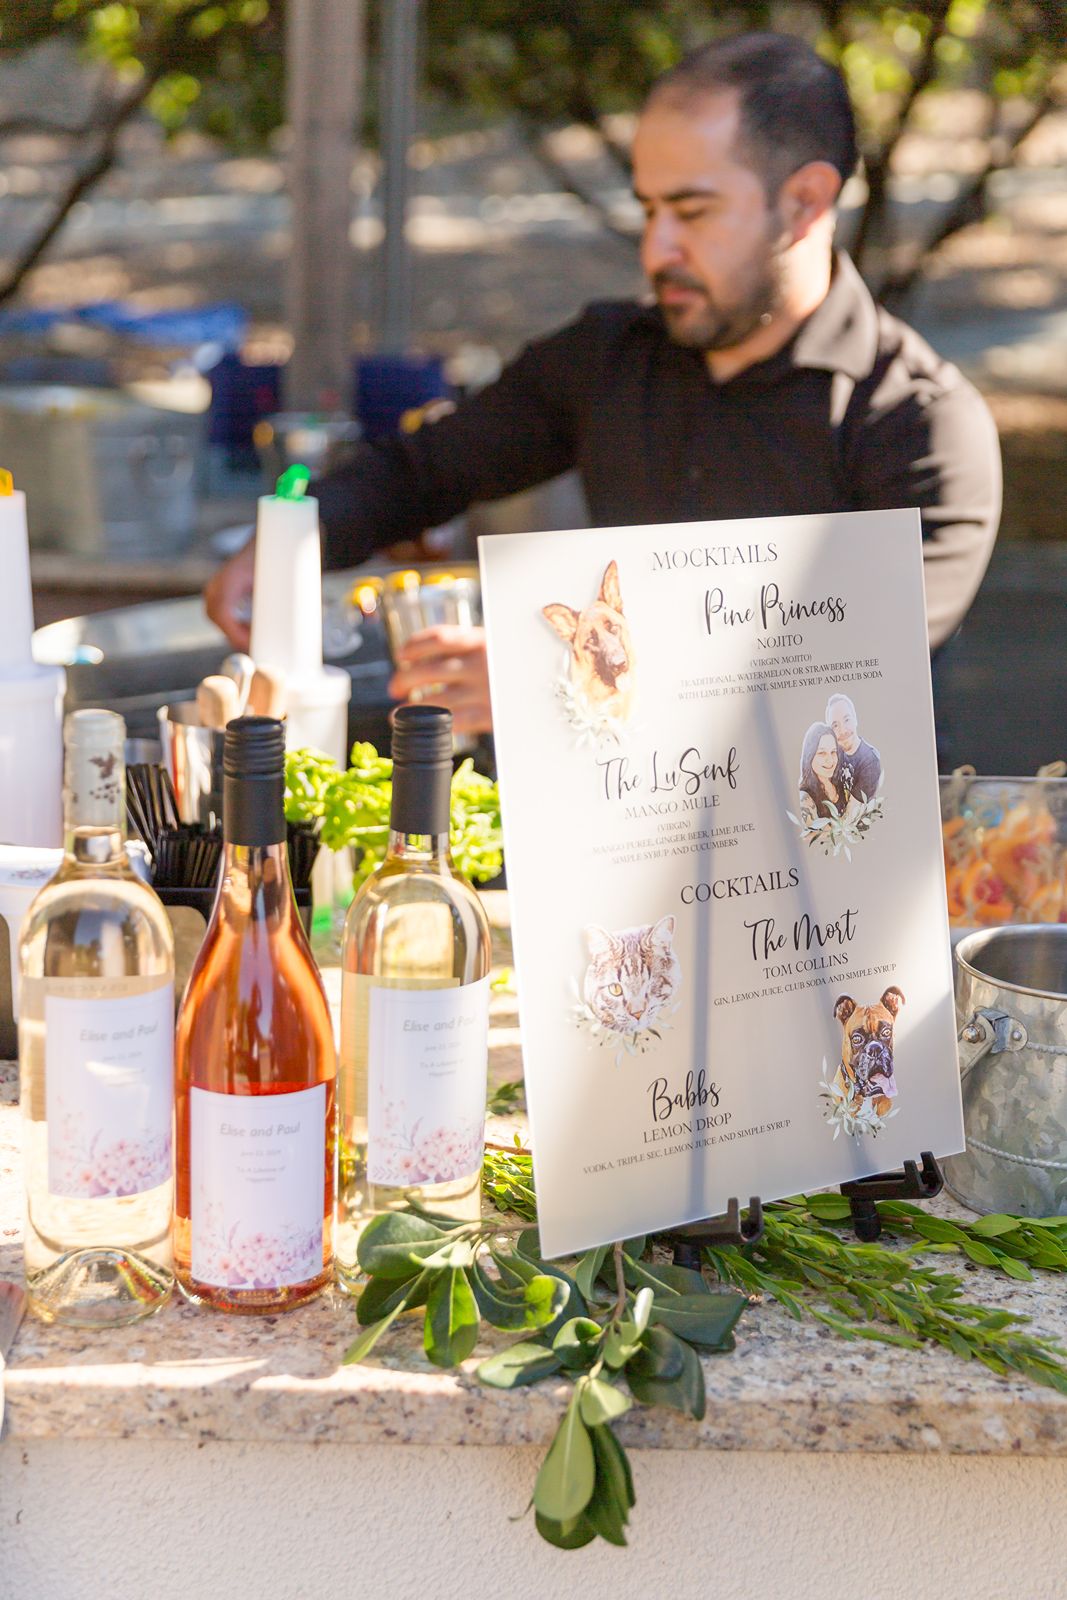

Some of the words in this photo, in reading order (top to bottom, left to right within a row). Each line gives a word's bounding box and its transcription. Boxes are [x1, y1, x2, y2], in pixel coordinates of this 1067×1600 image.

[652, 542, 778, 571] MOCKTAILS
[704, 587, 754, 635] Pine
[761, 583, 847, 630] Princess
[757, 633, 803, 649] NOJITO
[737, 667, 791, 681] WATERMELON
[792, 667, 804, 676] OR
[805, 661, 854, 674] STRAWBERRY
[855, 658, 879, 669] PUREE
[750, 656, 780, 667] (VIRGIN
[781, 654, 812, 664] MOJITO)
[678, 690, 699, 700] WITH
[700, 688, 721, 698] LIME
[747, 683, 769, 693] MINT,
[769, 678, 798, 690] SIMPLE
[799, 676, 823, 687] SYRUP
[824, 674, 841, 684] AND
[842, 672, 862, 682] CLUB
[863, 670, 883, 680] SODA
[596, 757, 641, 800] The
[624, 802, 678, 820] MANGO
[682, 795, 720, 812] MULE
[655, 834, 686, 846] GINGER
[711, 826, 732, 837] LIME
[657, 820, 691, 833] (VIRGIN)
[612, 853, 642, 865] SIMPLE
[643, 849, 669, 860] SYRUP
[670, 846, 690, 856] AND
[690, 838, 739, 853] CUCUMBERS
[680, 867, 800, 905] COCKTAILS
[743, 918, 787, 961] The
[793, 908, 859, 951] Mort
[763, 963, 793, 980] TOM
[795, 952, 849, 976] COLLINS
[713, 996, 731, 1007] GIN,
[731, 990, 760, 1003] LEMON
[760, 986, 784, 997] JUICE,
[784, 981, 805, 992] CLUB
[805, 978, 827, 989] SODA
[827, 974, 845, 984] AND
[845, 968, 873, 980] SIMPLE
[873, 963, 897, 976] SYRUP
[112, 1027, 135, 1040] and
[433, 1017, 455, 1031] and
[647, 1068, 722, 1122] Babbs
[249, 1124, 273, 1137] and
[276, 1121, 301, 1136] Paul
[643, 1121, 693, 1144] LEMON
[696, 1112, 732, 1132] DROP
[583, 1161, 615, 1175] VODKA,
[617, 1153, 646, 1168] TRIPLE
[647, 1149, 663, 1160] SEC,
[664, 1142, 694, 1156] LEMON
[695, 1137, 717, 1149] JUICE
[718, 1131, 736, 1143] AND
[737, 1125, 766, 1139] SIMPLE
[766, 1119, 791, 1133] SYRUP
